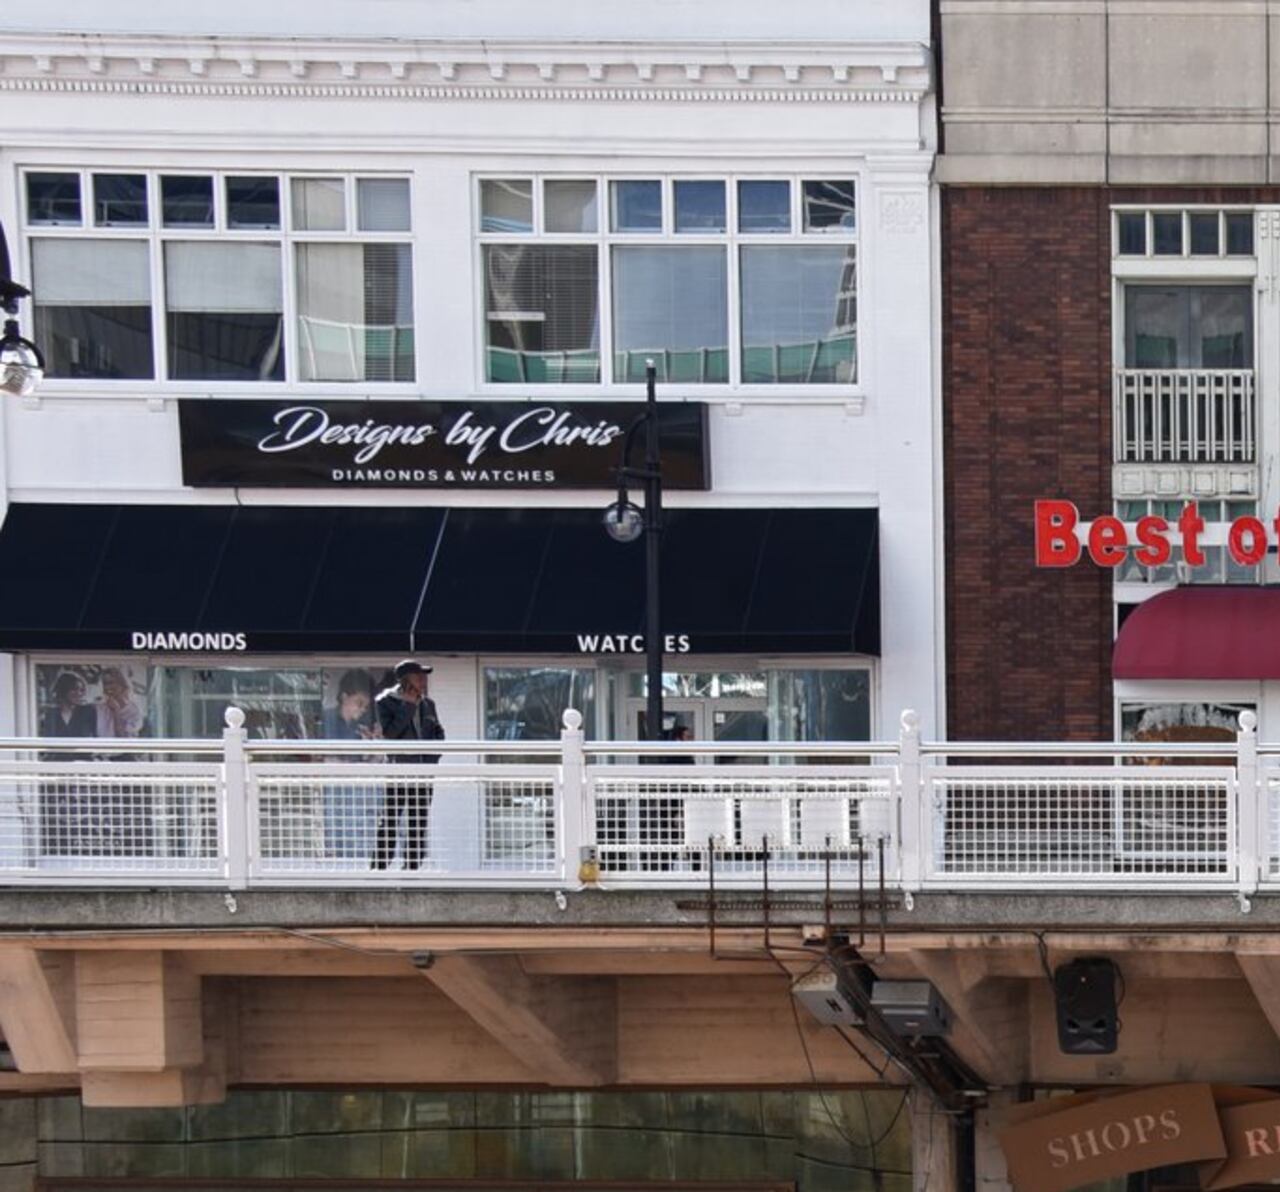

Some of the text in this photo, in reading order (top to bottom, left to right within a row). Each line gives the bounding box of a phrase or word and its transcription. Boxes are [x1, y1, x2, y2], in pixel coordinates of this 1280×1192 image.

[257, 405, 625, 465] Designs by Chris
[332, 469, 557, 483] DIAMONDS & WATCHES
[1034, 499, 1207, 569] Best
[131, 631, 248, 652] DIAMONDS
[577, 634, 691, 653] WATCES
[1047, 1110, 1183, 1169] SHOPS
